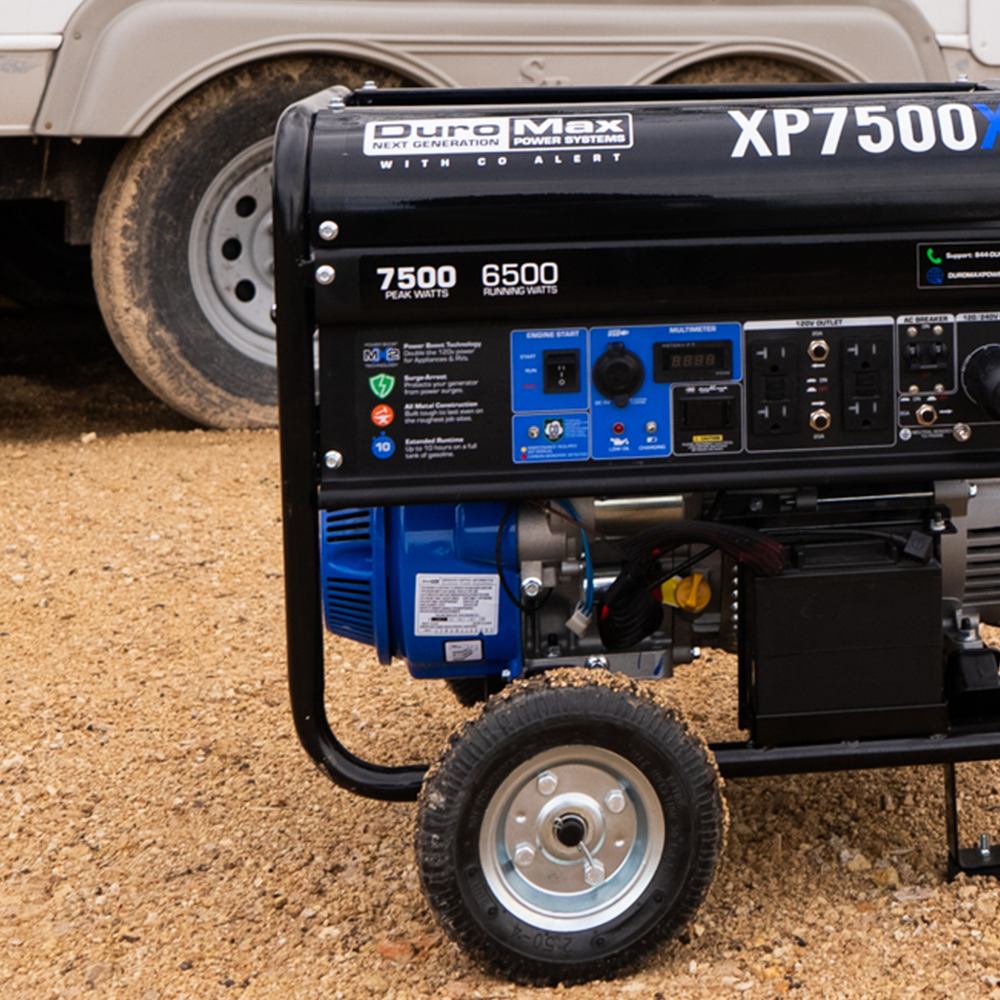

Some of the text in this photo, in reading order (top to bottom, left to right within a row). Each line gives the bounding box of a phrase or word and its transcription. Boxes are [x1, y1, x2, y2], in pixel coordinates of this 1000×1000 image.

[372, 117, 625, 140] Duro Max
[373, 138, 500, 150] NEXT GENERATION
[514, 134, 627, 146] POWER SYSTEMS
[380, 153, 621, 169] WITH CO ALERT
[376, 265, 457, 291] 7500
[481, 262, 558, 287] 6500
[385, 289, 449, 300] PEAK WATTS
[483, 285, 558, 296] RUNNING WATTS
[526, 330, 580, 339] ENGINE START
[669, 325, 717, 334] MULTIMETER
[446, 341, 482, 349] Technology
[375, 442, 391, 452] 10
